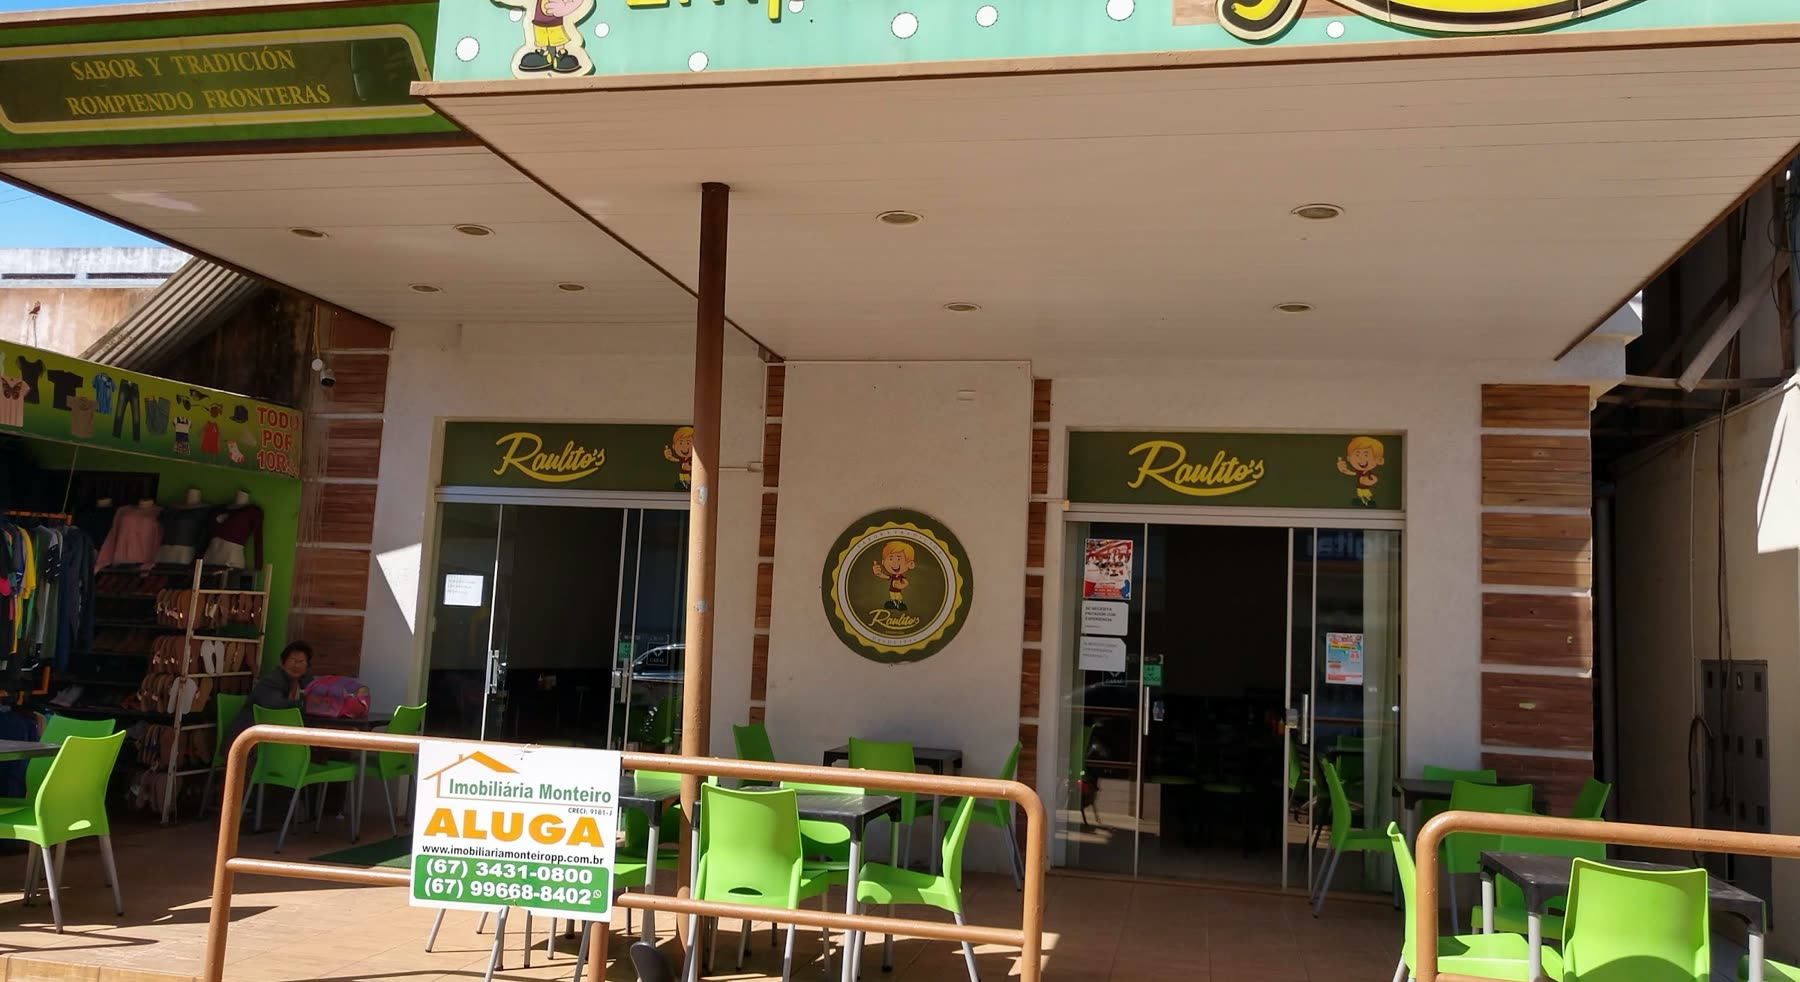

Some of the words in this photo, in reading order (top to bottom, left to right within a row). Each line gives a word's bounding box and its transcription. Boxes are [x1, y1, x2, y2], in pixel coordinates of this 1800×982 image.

[70, 57, 142, 81] SABOR
[147, 57, 163, 76] Y
[170, 46, 296, 75] TRADICIÓN
[65, 91, 194, 116] ROMPIENDO
[201, 84, 331, 109] FRONTERAS
[493, 431, 606, 483] Raulito's
[1127, 440, 1265, 497] Raulito's
[868, 609, 920, 630] Raulito's
[449, 778, 533, 799] Imobiliária
[539, 783, 612, 804] Monteiro
[423, 807, 605, 848] ALUGA
[422, 844, 604, 865] www.imobiliariamonteiropp.com.br
[426, 858, 468, 878] (67)
[475, 861, 593, 884] 3431-0800
[424, 877, 464, 899] (67)
[470, 880, 592, 905] 99668-8402
